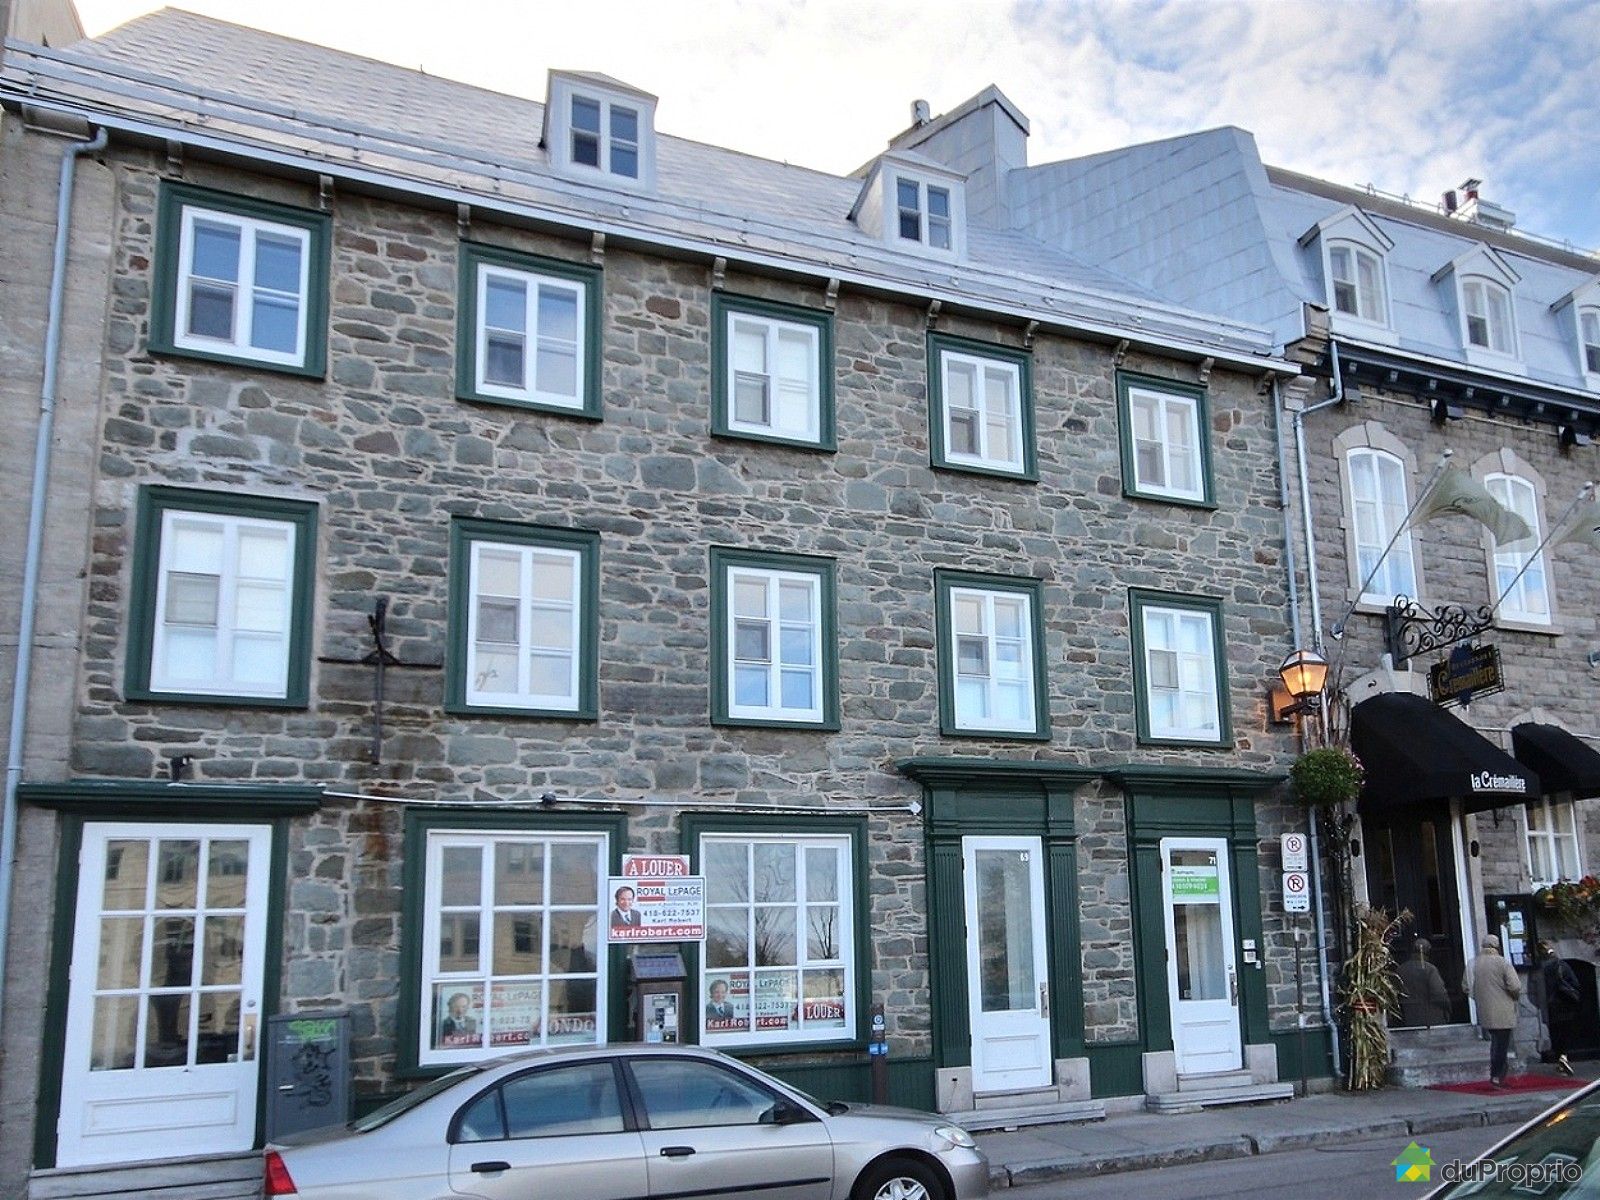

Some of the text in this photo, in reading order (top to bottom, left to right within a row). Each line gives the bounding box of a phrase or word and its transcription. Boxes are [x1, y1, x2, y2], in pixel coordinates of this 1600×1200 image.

[1208, 856, 1216, 865] 71
[629, 859, 683, 876] À LOUER
[636, 887, 666, 896] ROYAL
[612, 926, 702, 937] karlrobert.com
[806, 1003, 841, 1019] LOUER
[707, 1016, 787, 1028] KarlRort.com
